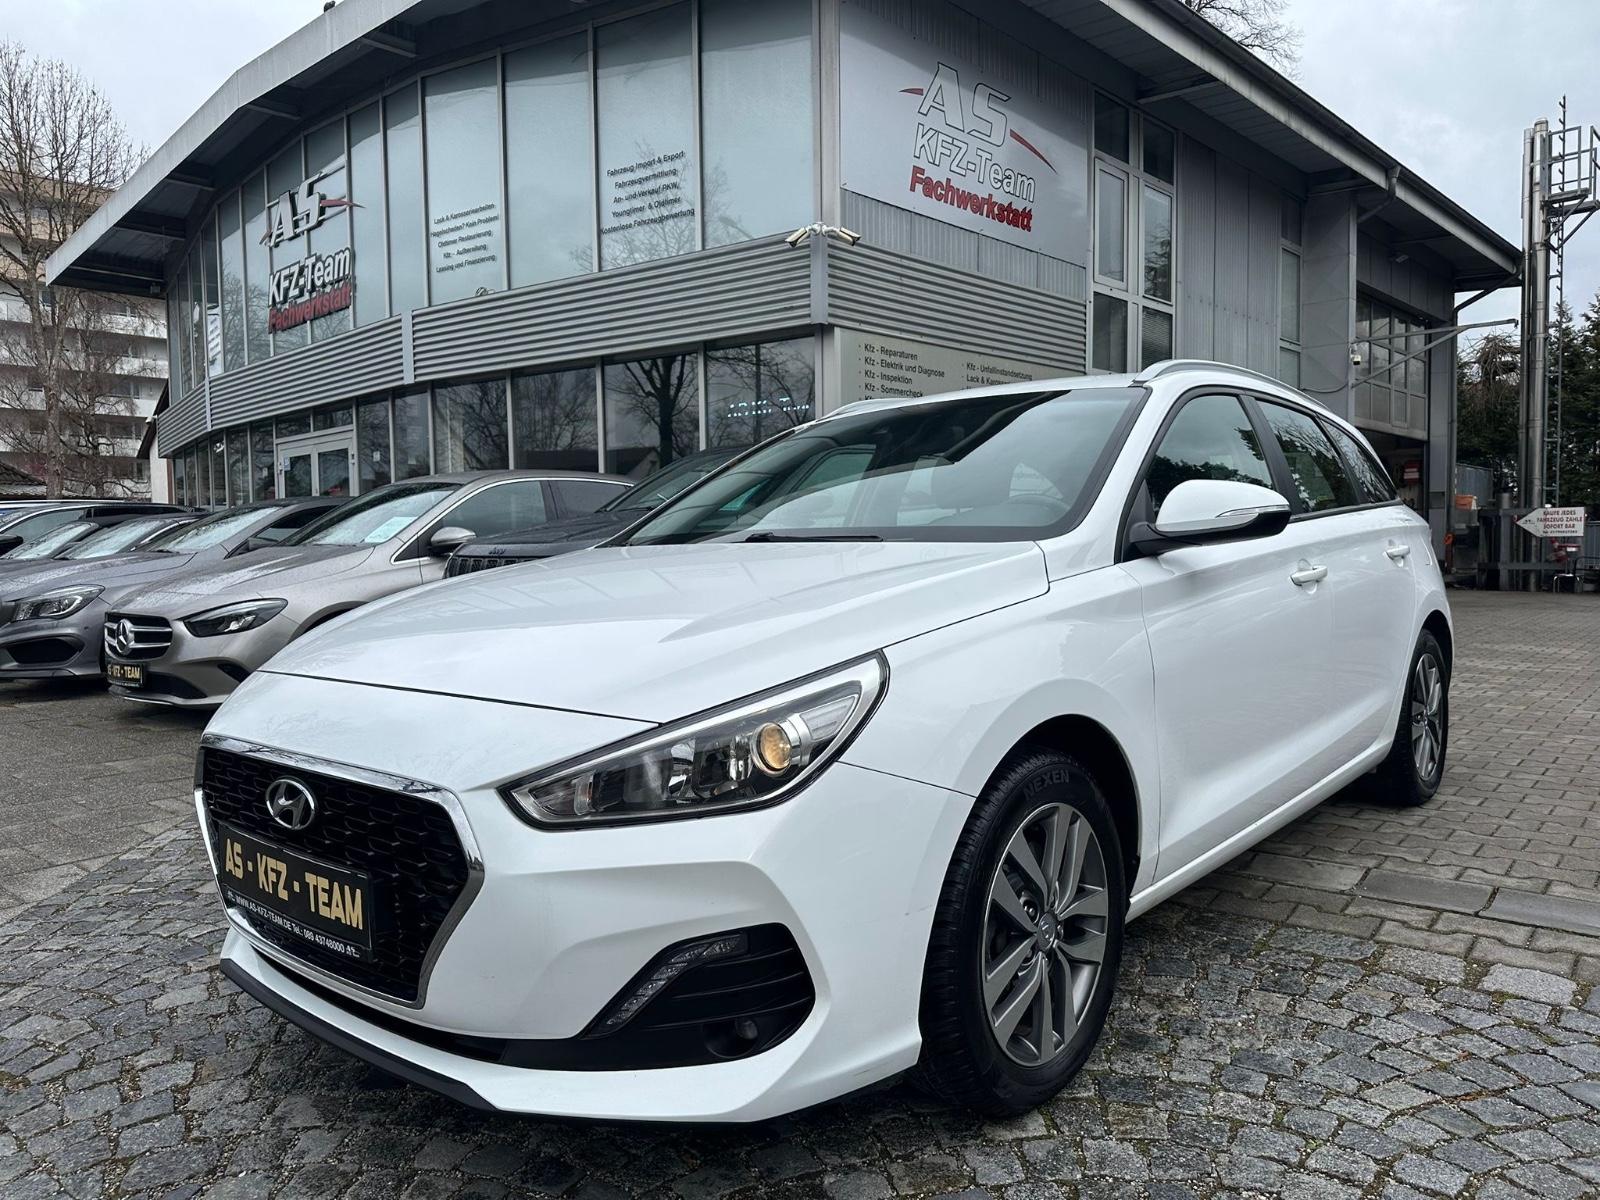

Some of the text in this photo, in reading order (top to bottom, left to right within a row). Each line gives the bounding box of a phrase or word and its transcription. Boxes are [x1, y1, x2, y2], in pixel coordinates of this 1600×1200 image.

[918, 61, 1012, 148] AS
[606, 164, 634, 176] Fahrzeug
[636, 159, 656, 170] Import
[913, 122, 1036, 203] KFZ-Team
[625, 192, 637, 200] und
[638, 186, 660, 198] Verkauf
[654, 196, 680, 208] Oldtimer
[910, 165, 1033, 232] Fachwerkstatt
[269, 172, 322, 247] AS
[600, 208, 694, 235] Kostenlose Fahrzeugbewertung
[268, 247, 351, 308] KFZ-Team
[268, 282, 352, 334] Fachwerkstatt
[864, 344, 875, 352] Kfz
[880, 346, 918, 360] Reparaturen
[864, 356, 875, 366] Kfz
[880, 359, 903, 370] Elektrik
[918, 366, 945, 377] Diagnose
[864, 370, 875, 378] Kfz
[881, 372, 912, 384] Inspektion
[967, 362, 976, 371] Kfz
[967, 374, 979, 383] Lack
[864, 383, 875, 392] Kfz
[880, 385, 923, 398] Sommercheck
[124, 666, 140, 678] TEAM
[1023, 770, 1070, 800] NEXEN
[226, 838, 243, 879] AS
[256, 852, 288, 901] KFZ
[305, 872, 363, 930] TEAM
[236, 896, 292, 930] WWW.AS-KFZ-TEAM.DE
[304, 928, 314, 941] 089
[315, 935, 345, 953] 43748000
